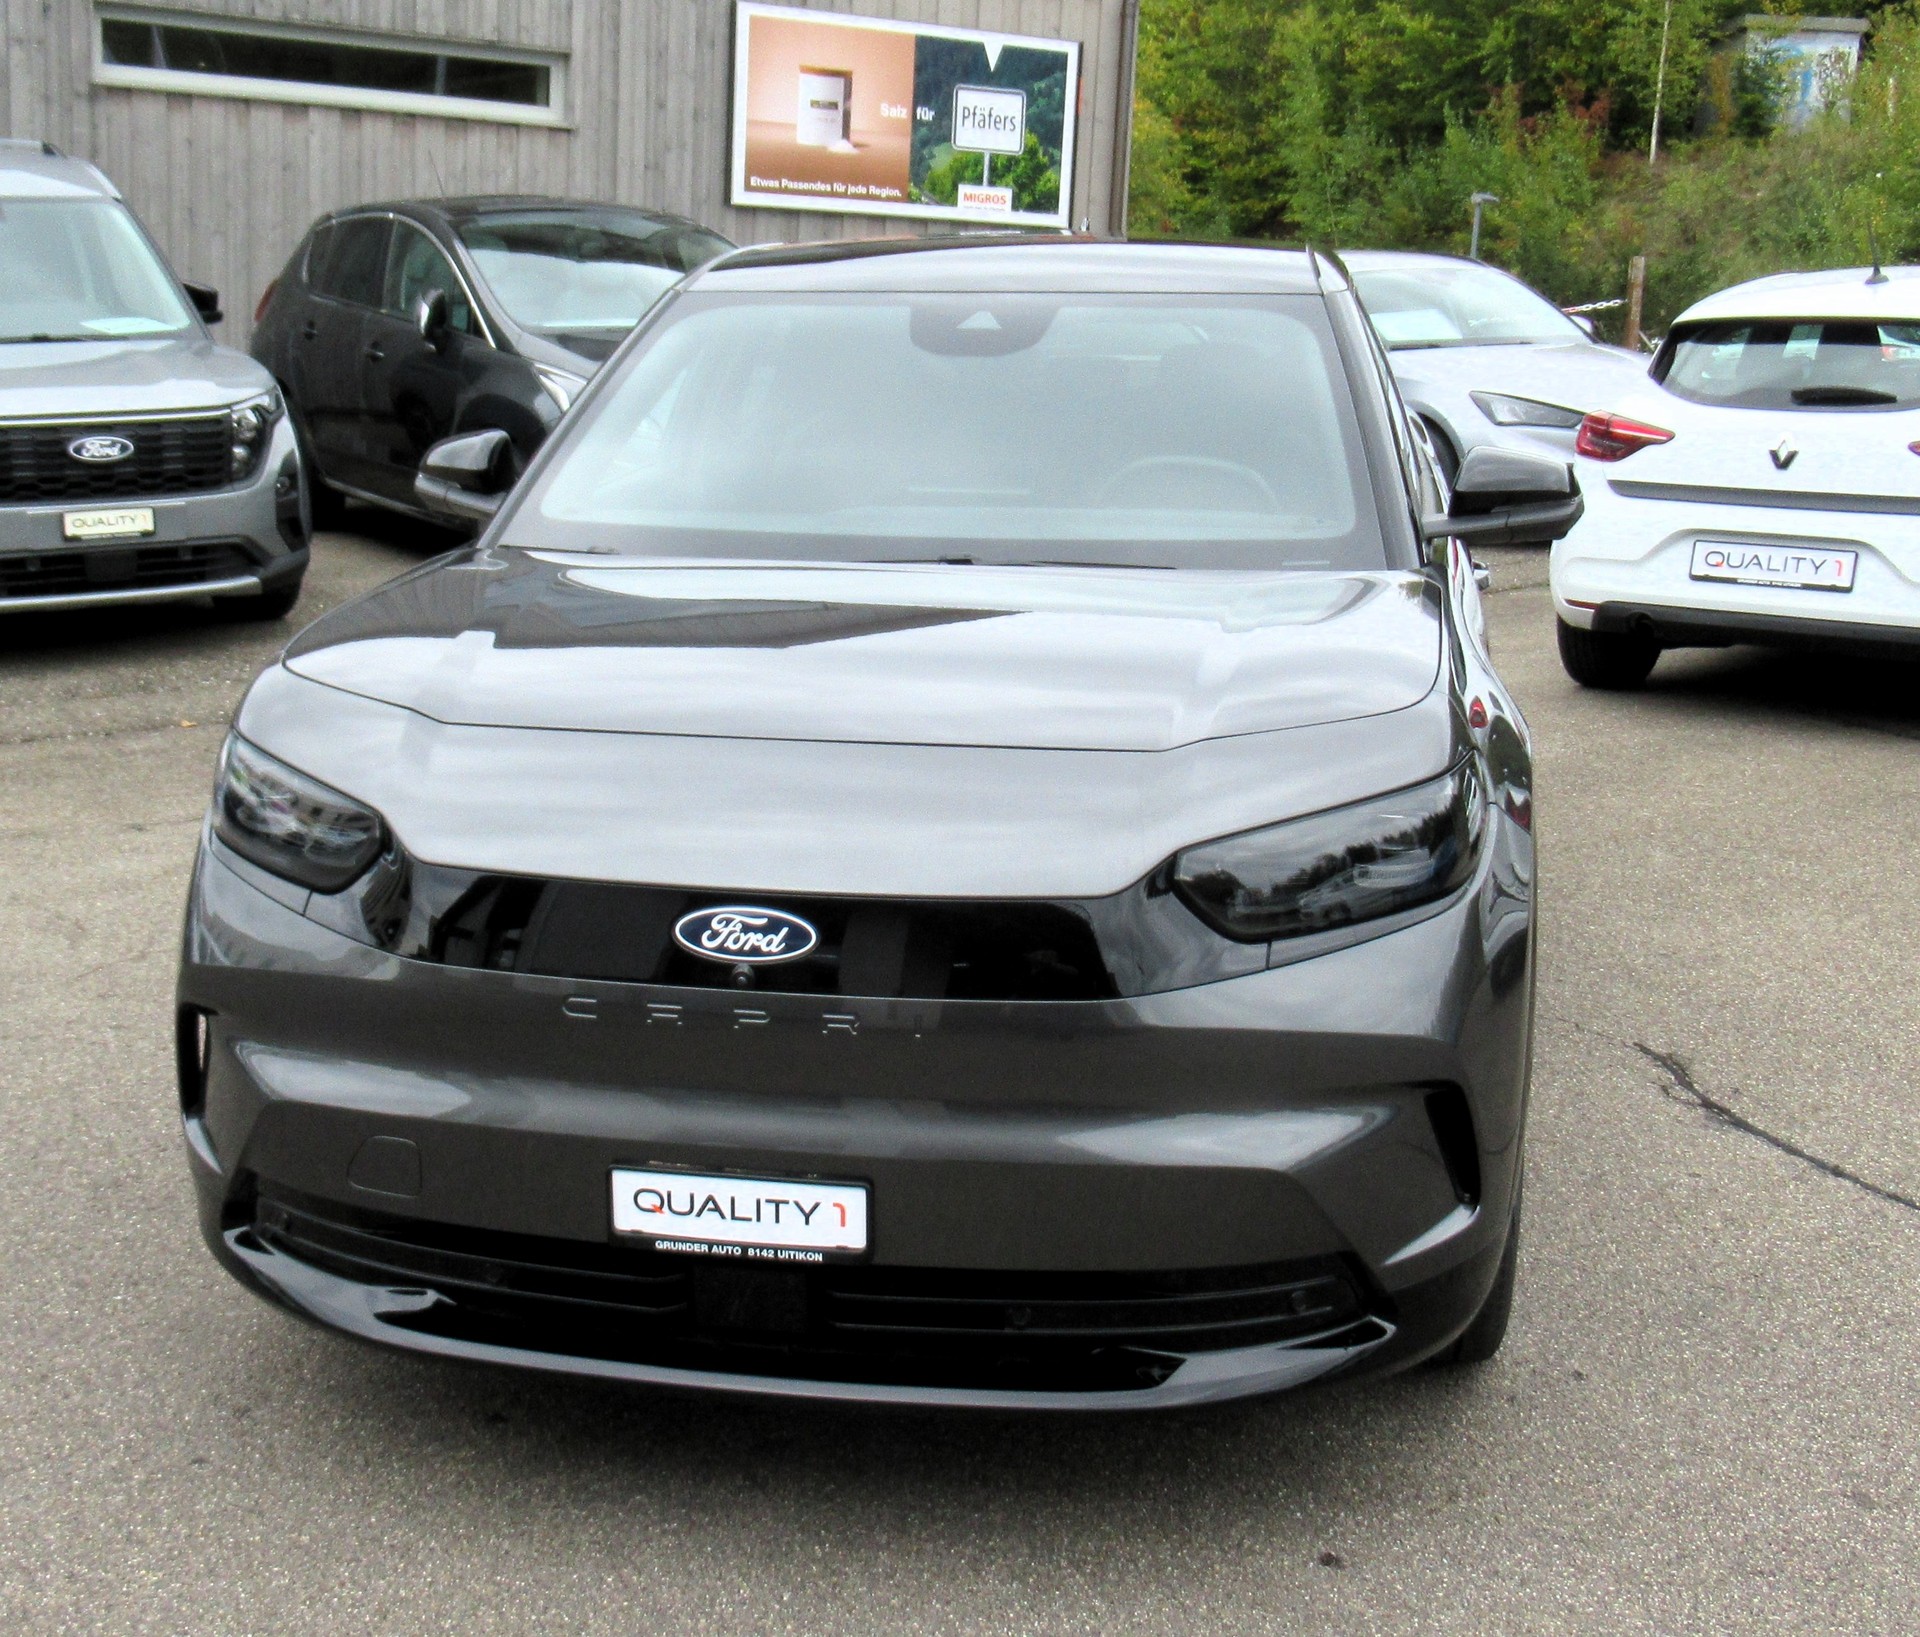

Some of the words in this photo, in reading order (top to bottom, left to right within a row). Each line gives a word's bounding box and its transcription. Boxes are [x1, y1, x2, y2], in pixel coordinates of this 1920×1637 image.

[880, 102, 908, 119] Salz
[916, 104, 936, 121] für
[962, 105, 1017, 132] Pfäfers
[750, 176, 780, 188] Etwas
[781, 178, 832, 192] Passendes
[833, 182, 847, 192] für
[848, 184, 867, 196] jede
[869, 185, 903, 198] Region.
[963, 192, 1007, 205] MIGROS
[72, 515, 136, 528] QUALITY
[1704, 550, 1827, 575] QUALITY
[1835, 560, 1844, 577] 1
[701, 913, 789, 954] Ford
[633, 1187, 821, 1227] QUALITY
[832, 1202, 846, 1227] 1
[655, 1240, 708, 1253] GRUNDER
[711, 1245, 741, 1255] AUTO
[747, 1247, 774, 1258] 8142
[777, 1249, 824, 1261] UITIKON
